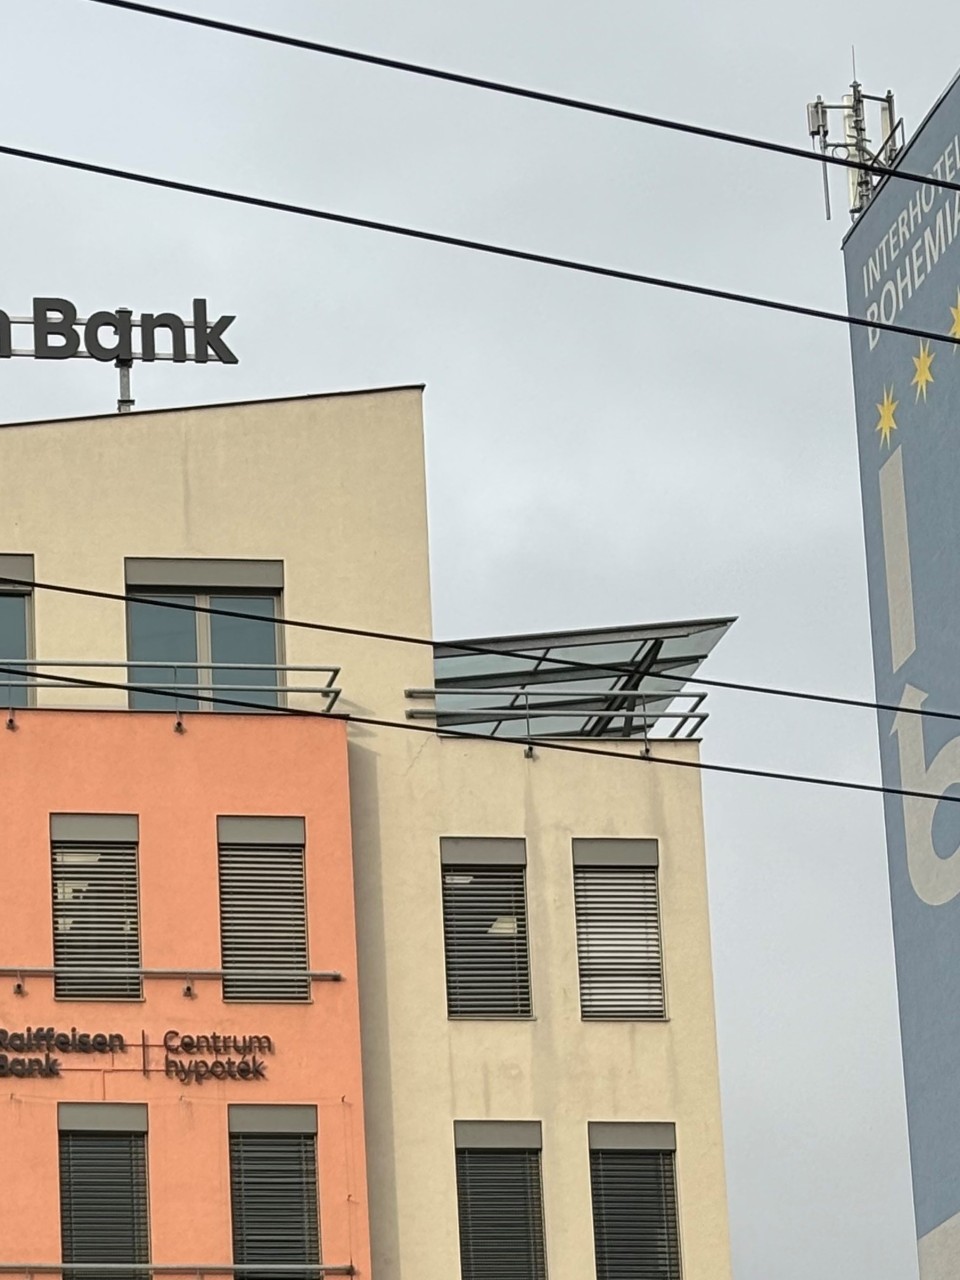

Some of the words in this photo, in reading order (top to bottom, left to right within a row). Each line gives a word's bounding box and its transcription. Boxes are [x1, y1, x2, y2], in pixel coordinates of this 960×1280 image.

[32, 296, 240, 364] Bank
[164, 1030, 273, 1055] Centrum
[165, 1054, 266, 1084] hypoték
